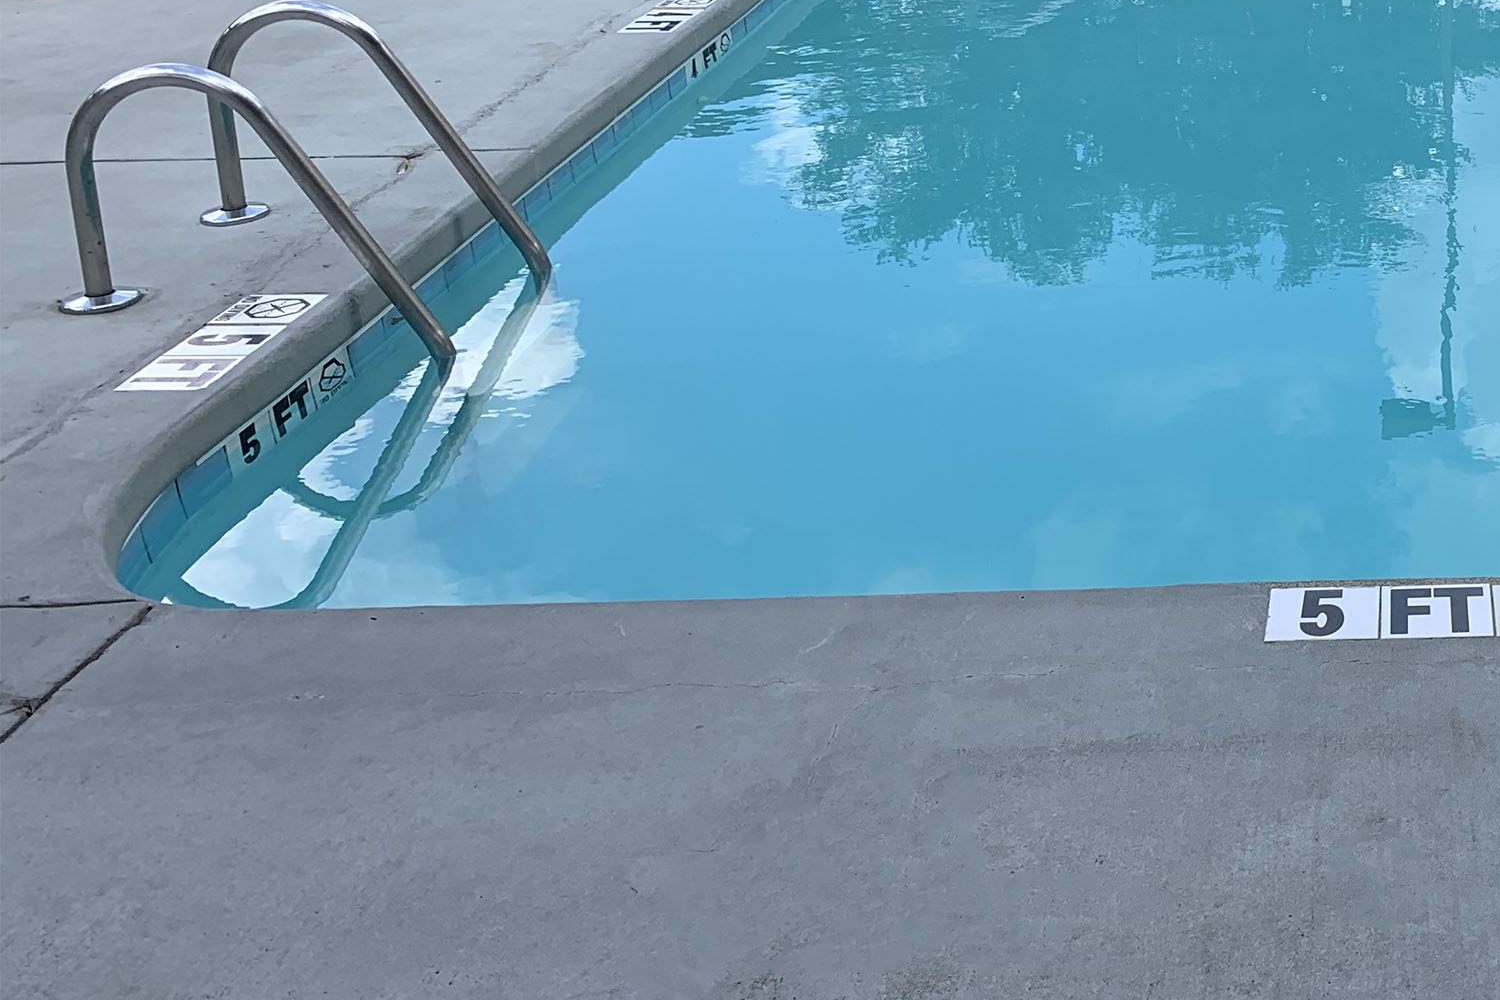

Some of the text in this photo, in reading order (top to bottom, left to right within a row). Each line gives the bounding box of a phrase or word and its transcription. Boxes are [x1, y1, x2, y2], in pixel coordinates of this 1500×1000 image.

[702, 41, 718, 69] FT
[130, 334, 272, 388] 5 FT
[238, 379, 310, 464] 5 FT
[1299, 586, 1484, 637] 5 FT
